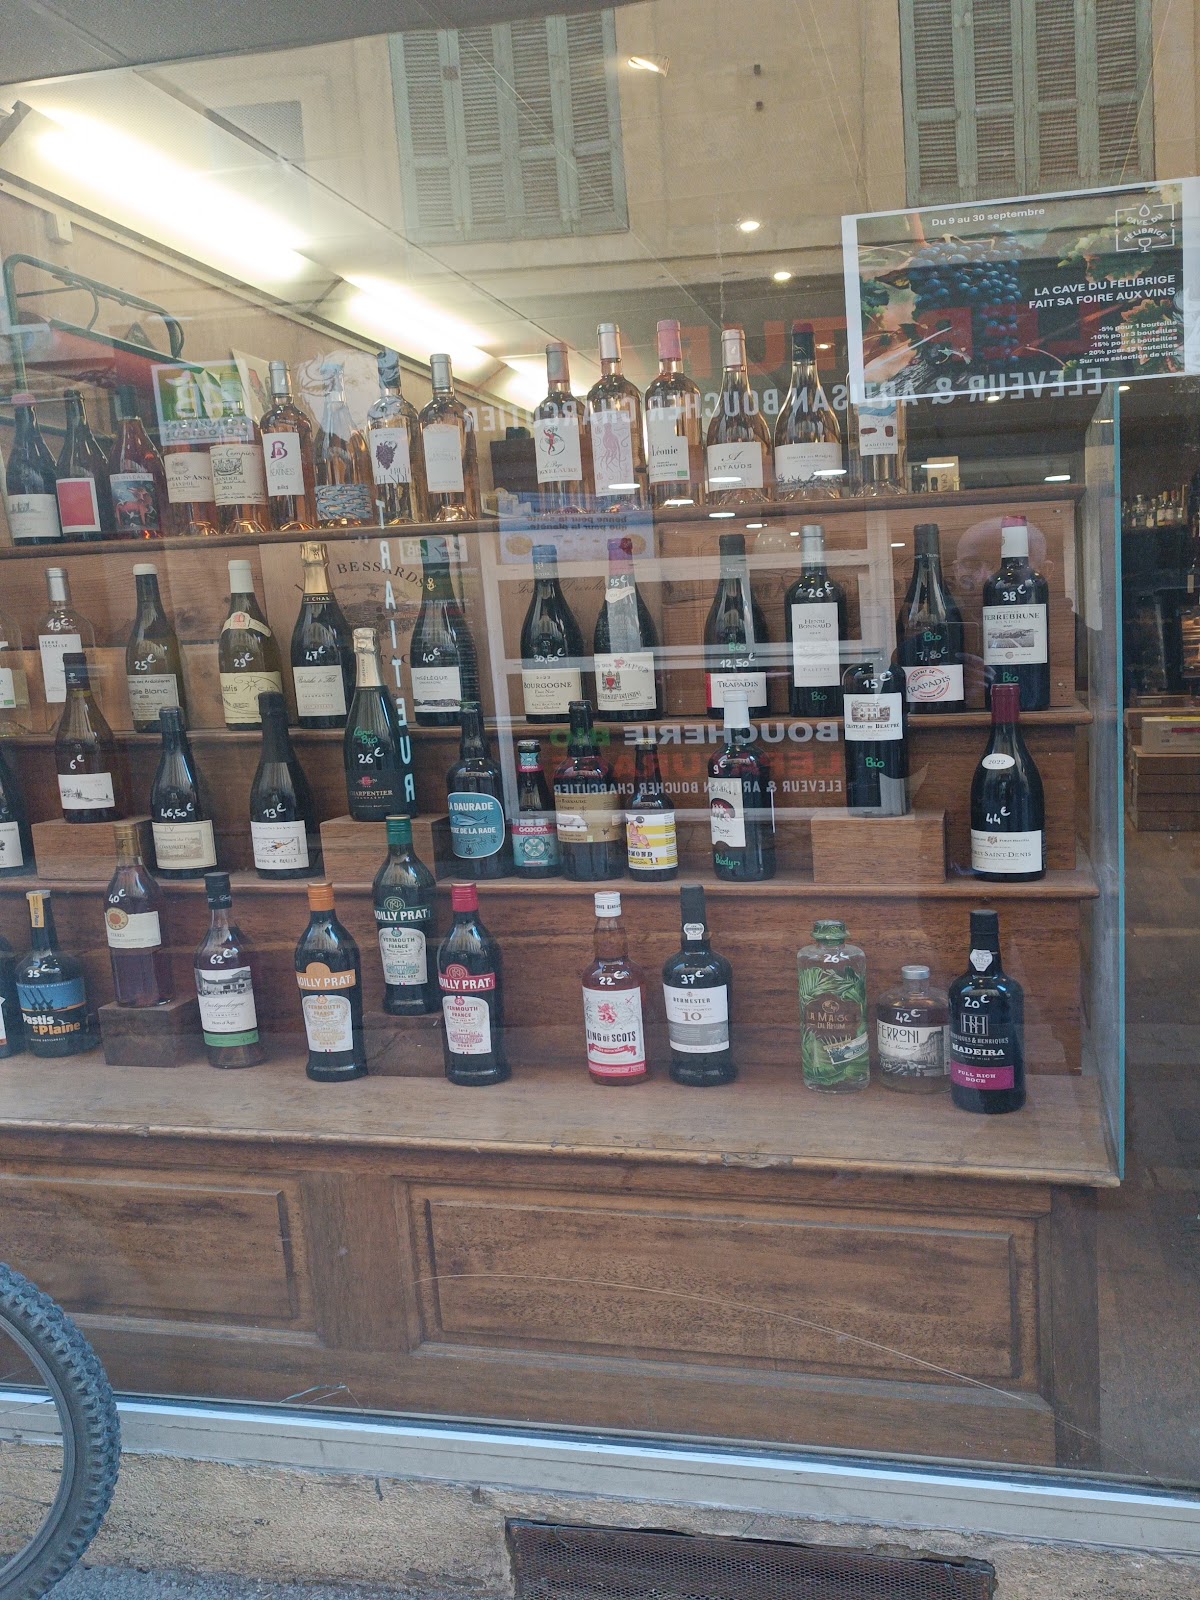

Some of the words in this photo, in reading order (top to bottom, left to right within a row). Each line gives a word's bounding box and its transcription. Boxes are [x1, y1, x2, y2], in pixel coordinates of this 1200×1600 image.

[957, 216, 970, 224] au
[972, 214, 985, 222] 30
[987, 208, 1045, 220] septembre
[1034, 287, 1050, 296] LA
[1052, 283, 1086, 294] CAVE
[1088, 281, 1107, 291] DU
[1029, 298, 1054, 309] FAIT
[1057, 297, 1073, 306] SA
[1077, 292, 1114, 305] FOIRE
[1116, 290, 1142, 301] AUX
[1144, 287, 1176, 298] VINS
[1115, 324, 1134, 332] pour
[1110, 332, 1130, 340] pour
[1111, 339, 1130, 348] pour
[1107, 347, 1126, 356] pour
[807, 581, 834, 599] 26€
[1002, 584, 1027, 602] 38€
[923, 631, 942, 642] Bio
[728, 641, 747, 652] Bio
[134, 653, 157, 671] 25€
[233, 652, 254, 668] 29€
[305, 647, 326, 662] 47€
[422, 647, 441, 664] 40€
[533, 648, 565, 665] 30,50€
[719, 652, 756, 668] 12,50€
[915, 647, 949, 662] 7,80€
[862, 670, 892, 689] 15€
[1002, 671, 1019, 683] Bio
[811, 691, 828, 700] Bio
[70, 754, 85, 770] 6€
[358, 747, 385, 764] 26€
[865, 757, 885, 769] Bio
[160, 803, 195, 820] 46,50€
[263, 803, 287, 819] 13€
[454, 801, 495, 811] DAURADE
[986, 806, 1011, 825] 44€
[108, 889, 127, 904] 40€
[400, 908, 427, 921] PRAT
[210, 948, 233, 965] 62€
[823, 952, 850, 963] 26€
[27, 963, 50, 978] 35€
[599, 970, 625, 986] 22€
[681, 970, 705, 985] 37€
[324, 974, 351, 987] PRAT
[462, 977, 491, 989] PRAT
[964, 994, 990, 1009] 20€
[22, 1012, 55, 1025] Pastis
[682, 1011, 703, 1021] 10
[895, 1008, 921, 1024] 42€
[39, 1022, 81, 1036] Plaine
[611, 1031, 636, 1042] SCOTS
[877, 1022, 920, 1044] FERRONI
[952, 1043, 1005, 1056] MADEIRA
